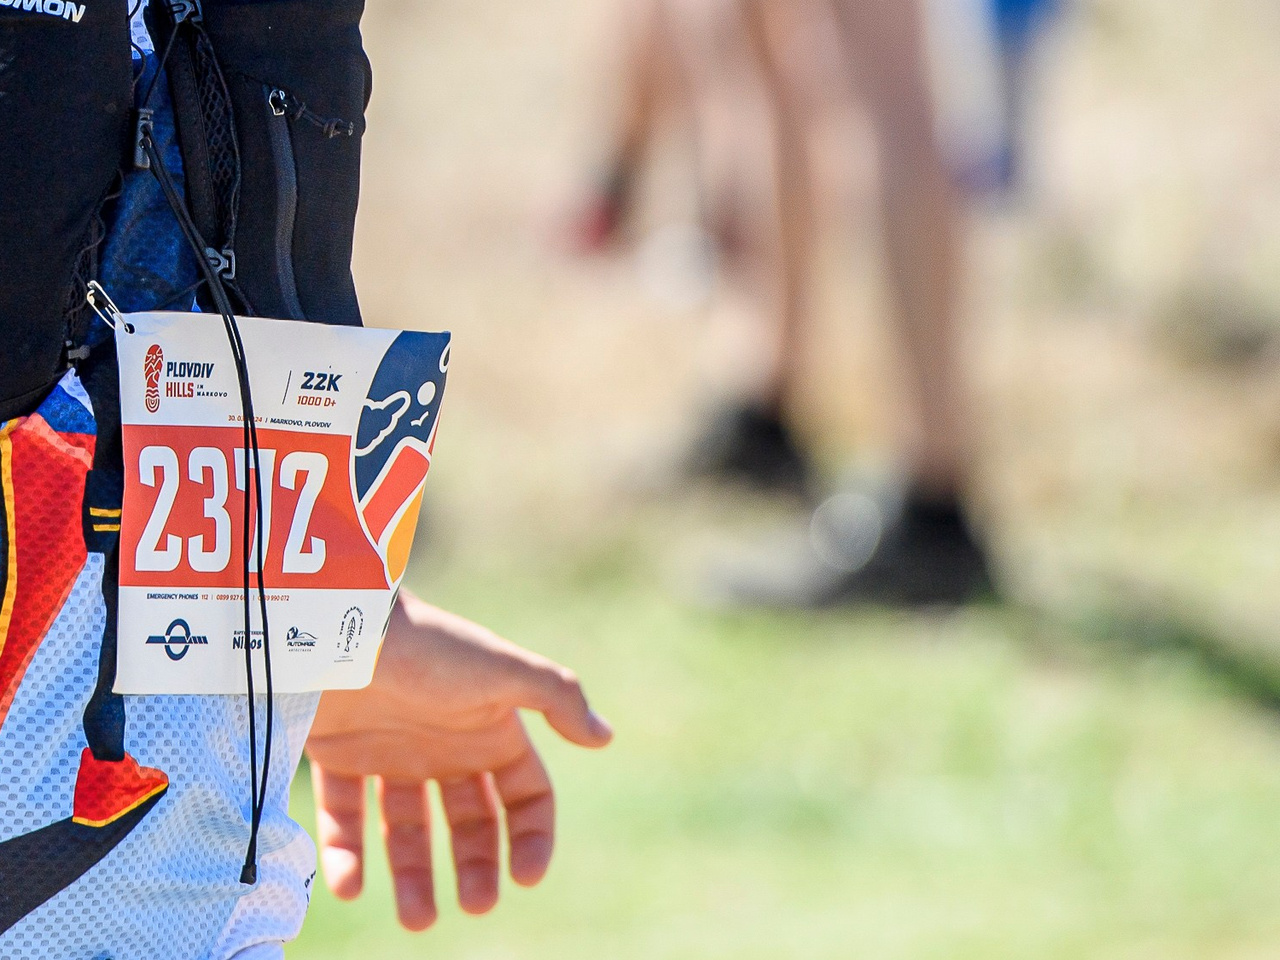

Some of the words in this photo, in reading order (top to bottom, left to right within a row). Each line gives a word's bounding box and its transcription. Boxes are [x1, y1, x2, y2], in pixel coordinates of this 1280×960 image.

[166, 361, 215, 379] PLOVDIV
[165, 381, 195, 399] HILLS
[300, 371, 343, 393] 22K
[305, 420, 332, 429] PLOVDIV
[134, 445, 329, 574] 2372
